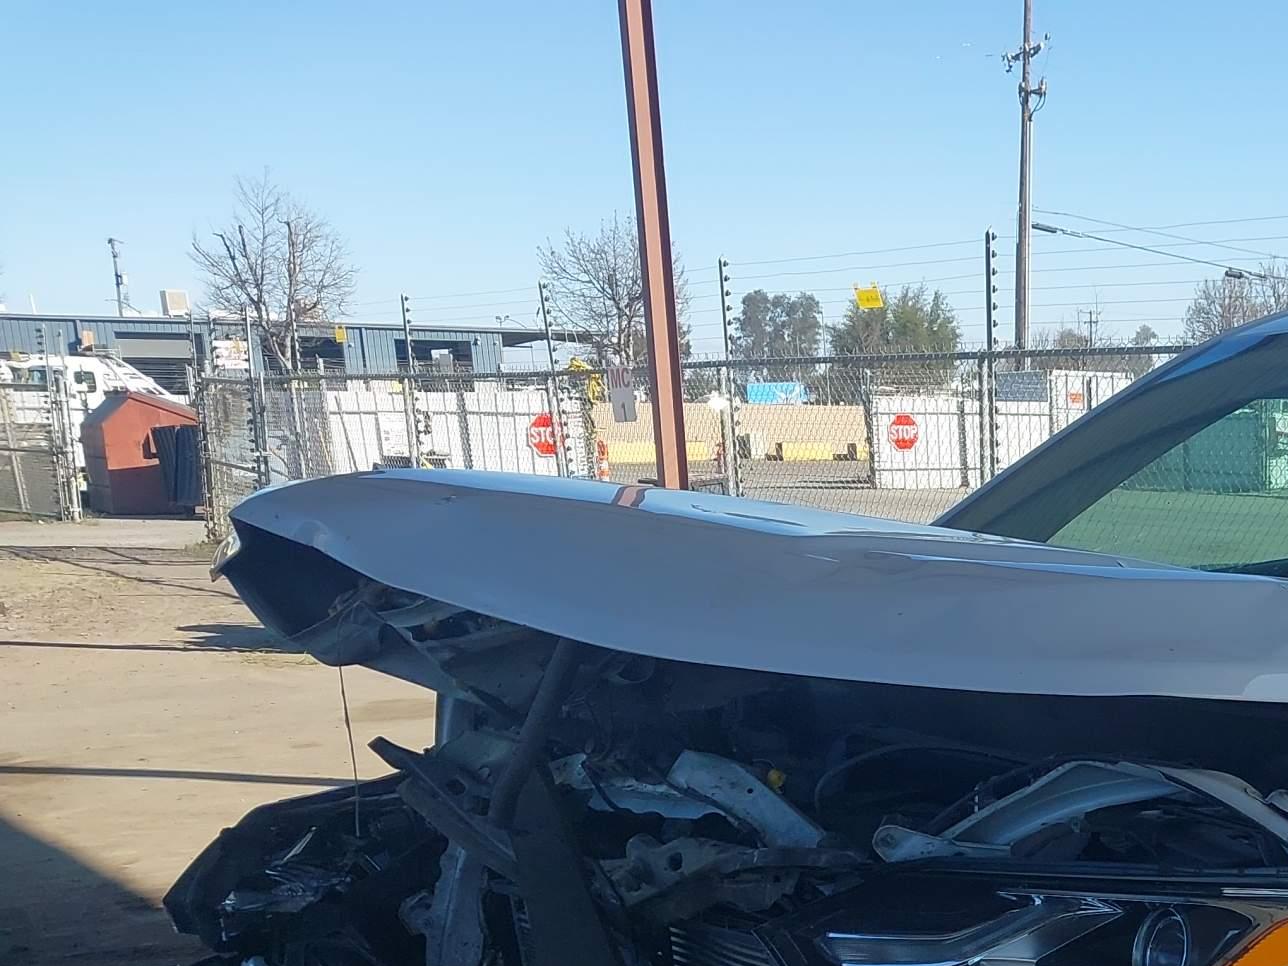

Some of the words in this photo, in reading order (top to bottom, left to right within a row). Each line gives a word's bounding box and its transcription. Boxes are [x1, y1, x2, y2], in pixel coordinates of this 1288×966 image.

[610, 367, 631, 389] MC
[530, 426, 557, 445] STO
[890, 424, 918, 440] STOP
